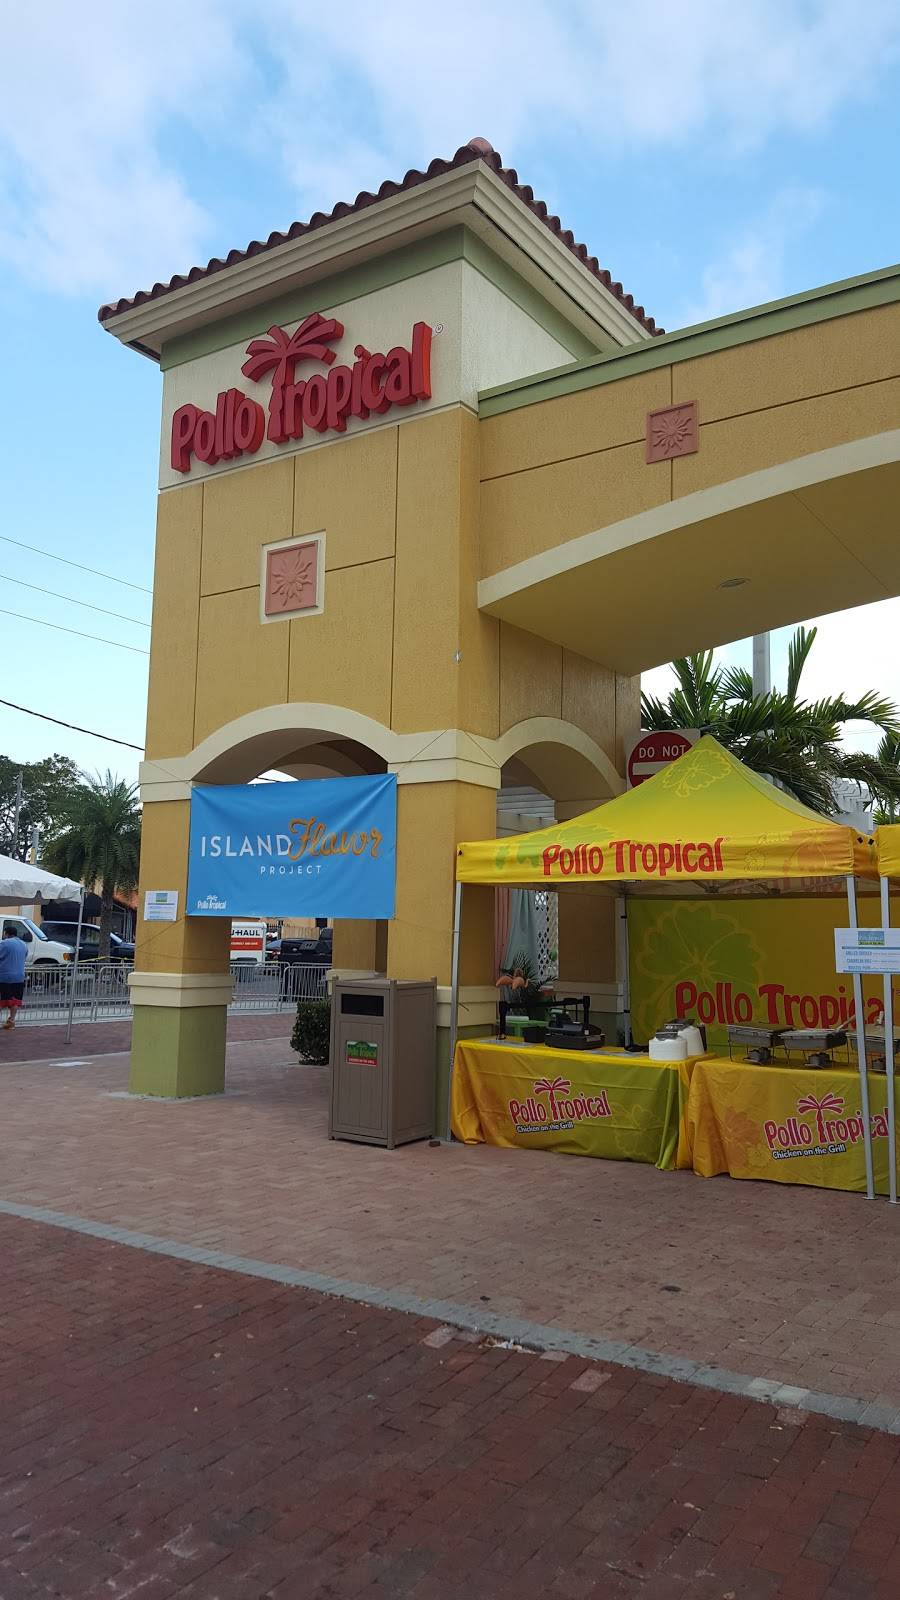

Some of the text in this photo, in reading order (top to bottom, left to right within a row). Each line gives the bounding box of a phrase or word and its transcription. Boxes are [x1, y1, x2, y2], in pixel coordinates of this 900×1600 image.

[171, 312, 433, 473] Pollo Tropical
[639, 744, 687, 759] DO NOT
[200, 816, 382, 861] ISLAND Flavor
[260, 865, 322, 875] PROJECT
[543, 837, 724, 876] Pollo Tropical
[675, 980, 893, 1029] Pollo Tropia
[509, 1077, 612, 1125] Pollo Tropical
[516, 1125, 540, 1133] Chicken
[764, 1118, 812, 1150] Pollo
[772, 1149, 802, 1159] Chicken
[815, 1146, 827, 1154] the
[828, 1144, 846, 1153] Grill
